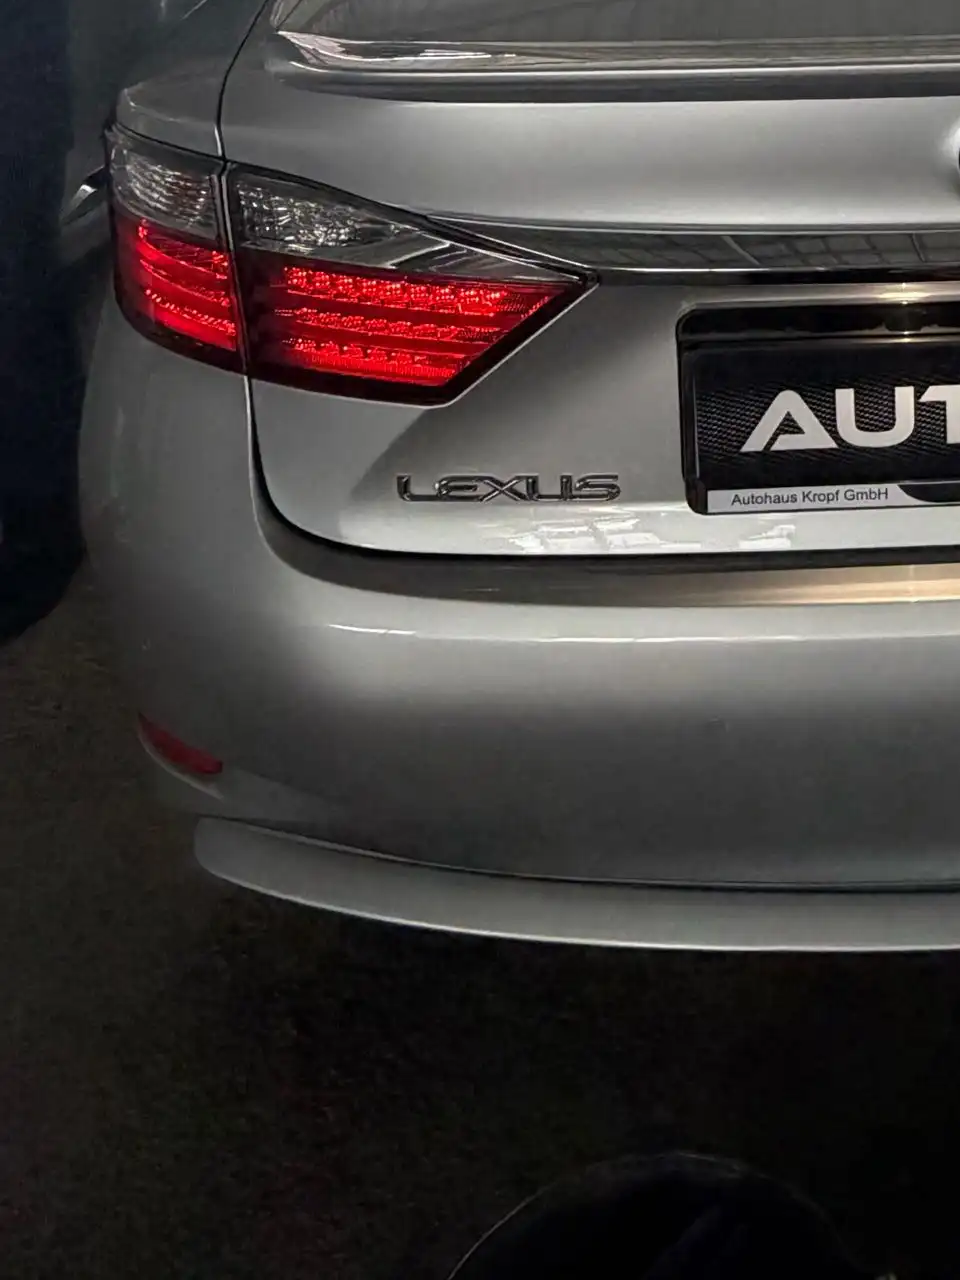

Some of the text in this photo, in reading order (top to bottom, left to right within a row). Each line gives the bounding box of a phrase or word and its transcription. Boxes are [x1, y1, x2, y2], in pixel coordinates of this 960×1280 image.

[396, 473, 622, 503] LEXUS
[731, 487, 889, 507] Autohaus Kropf GmbH
